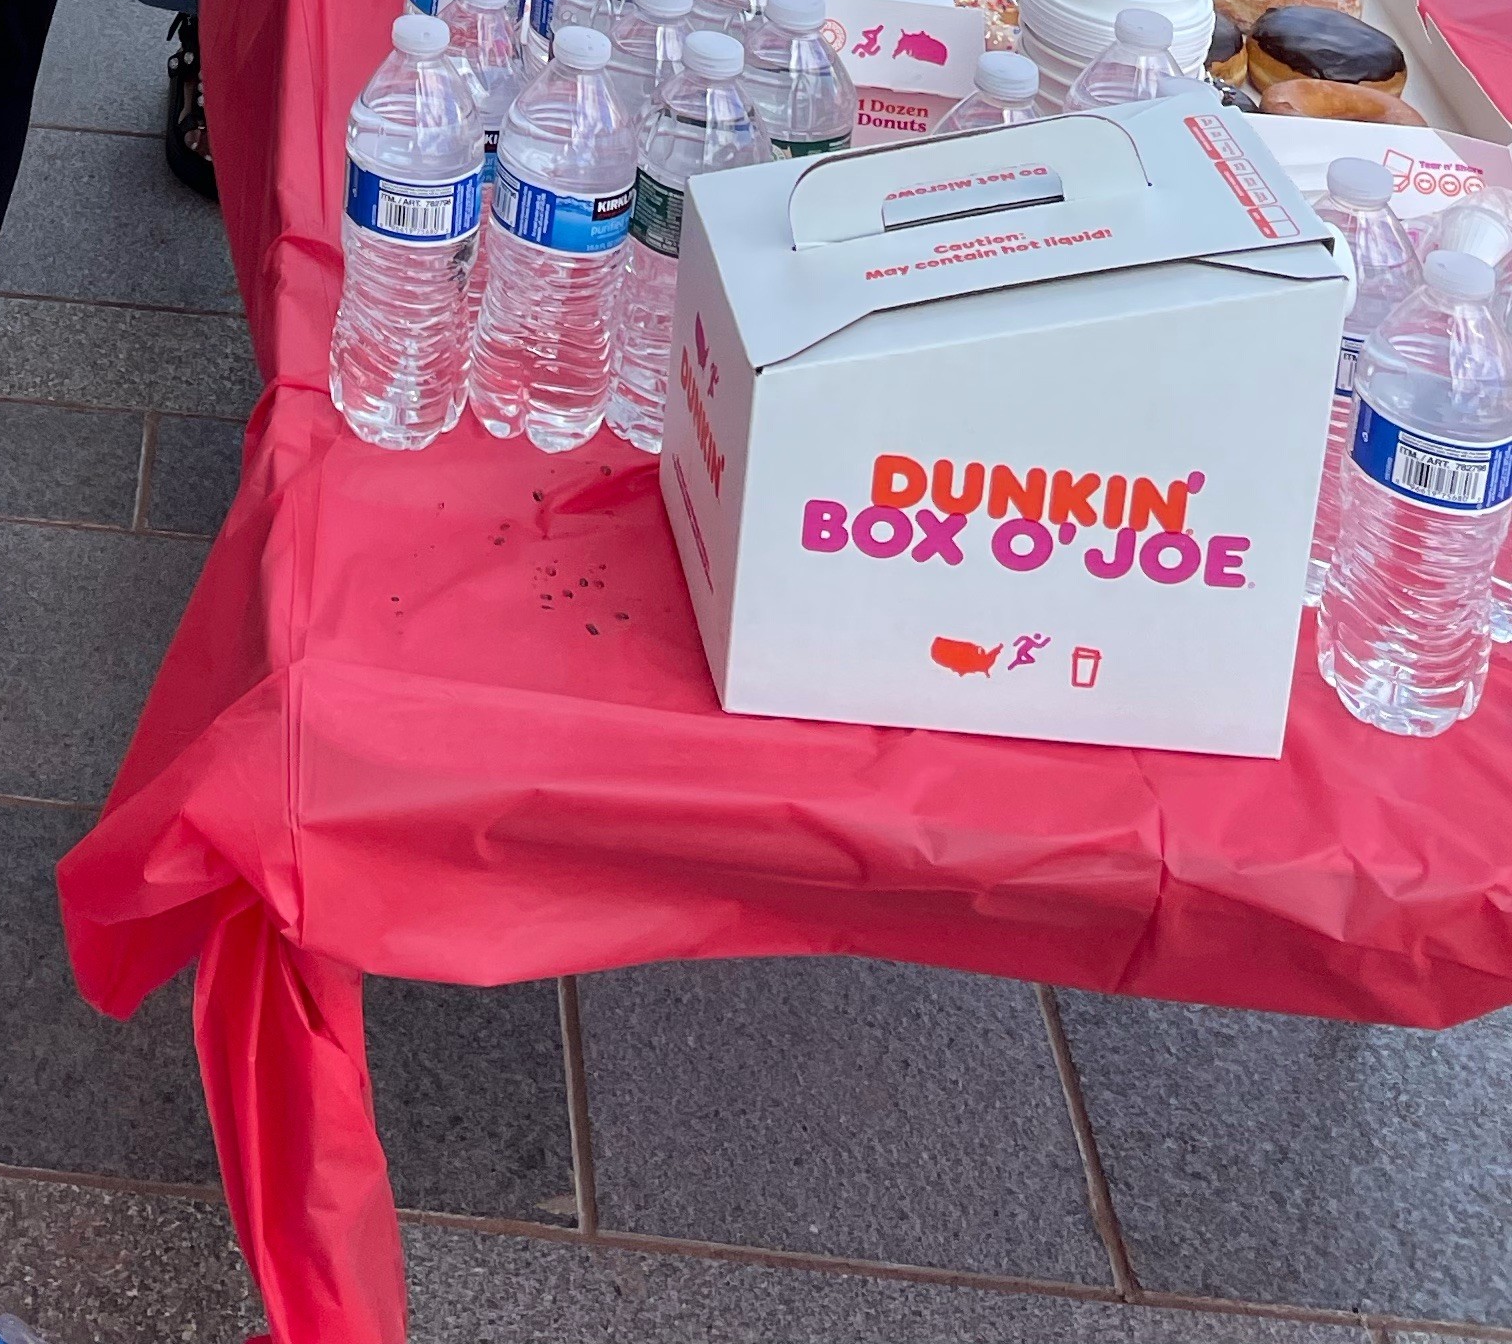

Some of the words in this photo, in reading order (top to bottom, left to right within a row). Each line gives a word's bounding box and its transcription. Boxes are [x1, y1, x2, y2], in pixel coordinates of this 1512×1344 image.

[858, 98, 865, 111] 1
[871, 99, 928, 118] Dozen
[858, 113, 927, 133] Donuts
[976, 171, 1016, 185] Not
[1019, 166, 1048, 176] Do
[886, 179, 973, 201] Microwa
[598, 193, 629, 212] KIRKL
[933, 232, 1027, 254] Caution:
[865, 264, 909, 281] May
[915, 248, 997, 270] contain
[1001, 240, 1040, 255] hot
[1044, 228, 1113, 249] liquid!
[1427, 457, 1450, 469] ART.
[1455, 463, 1487, 472] 782796
[871, 454, 1205, 534] DUNKIN'
[801, 499, 968, 566] BOX
